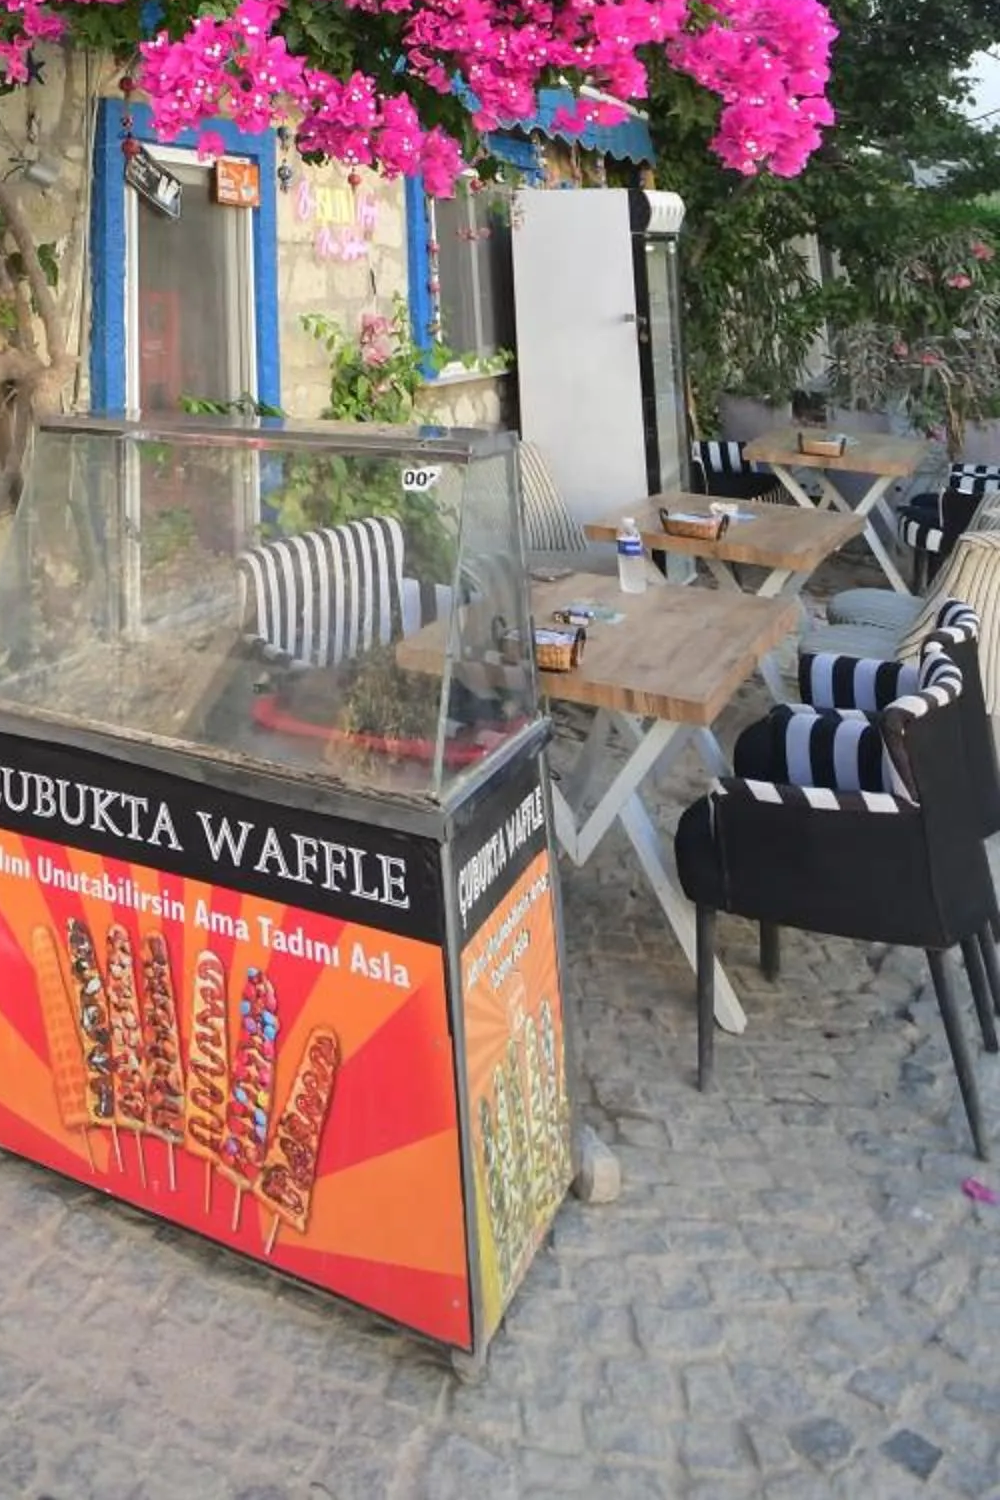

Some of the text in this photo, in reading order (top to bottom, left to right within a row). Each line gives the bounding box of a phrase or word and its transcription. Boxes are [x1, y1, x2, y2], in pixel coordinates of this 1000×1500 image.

[195, 810, 410, 910] WAFFLE
[194, 898, 250, 943] Ama
[257, 914, 341, 968] Tadını
[351, 941, 411, 990] Asla
